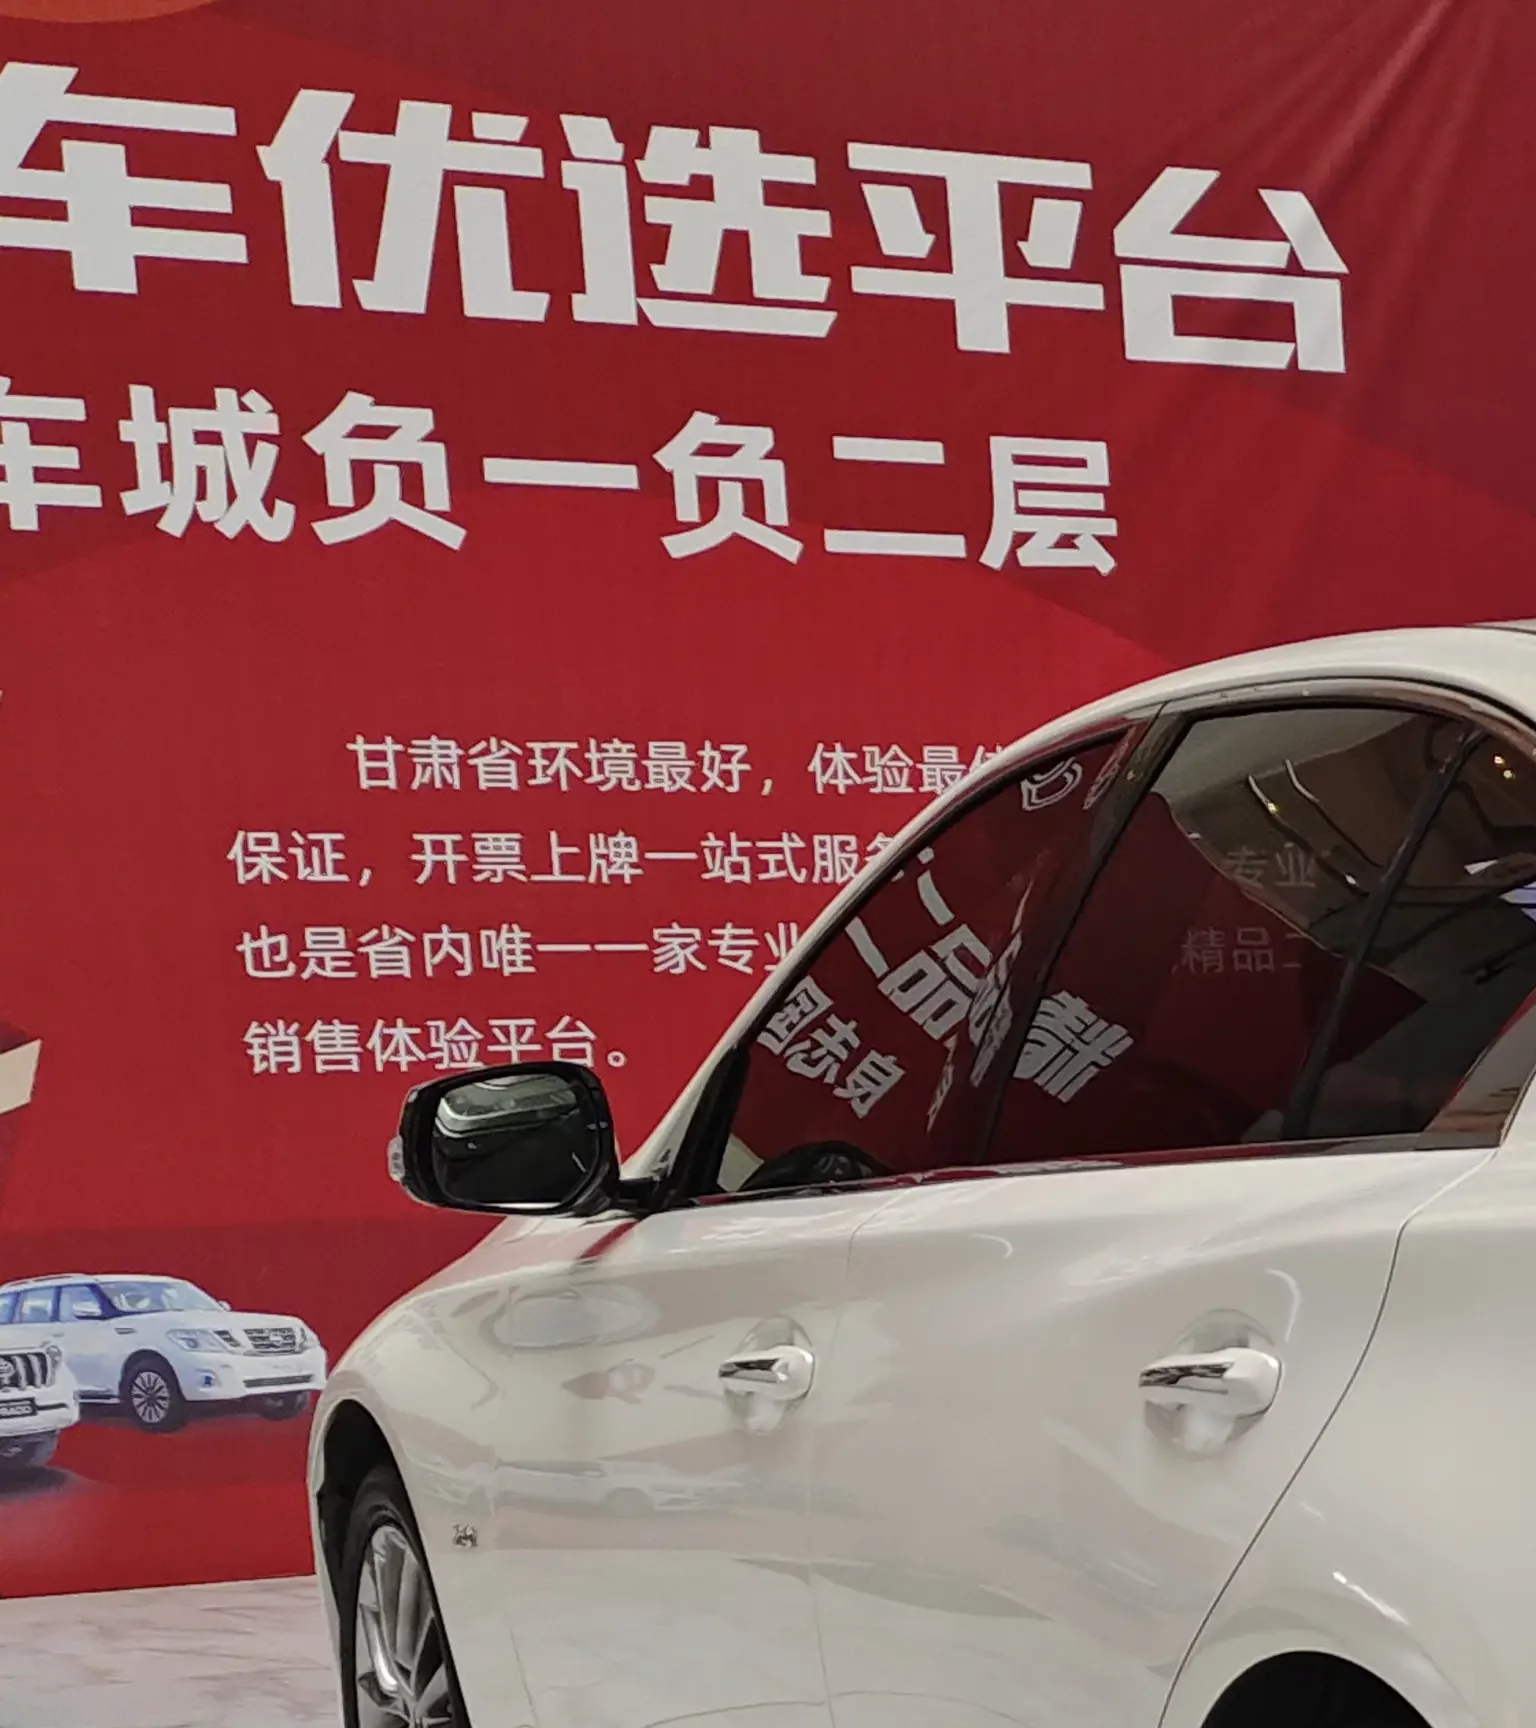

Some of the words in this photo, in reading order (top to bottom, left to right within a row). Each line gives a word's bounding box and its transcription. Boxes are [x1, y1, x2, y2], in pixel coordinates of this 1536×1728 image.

[0, 60, 1348, 373] 车优选平台
[0, 375, 1119, 576] 车城负一负二层
[243, 1014, 627, 1075] 销售体验平台。
